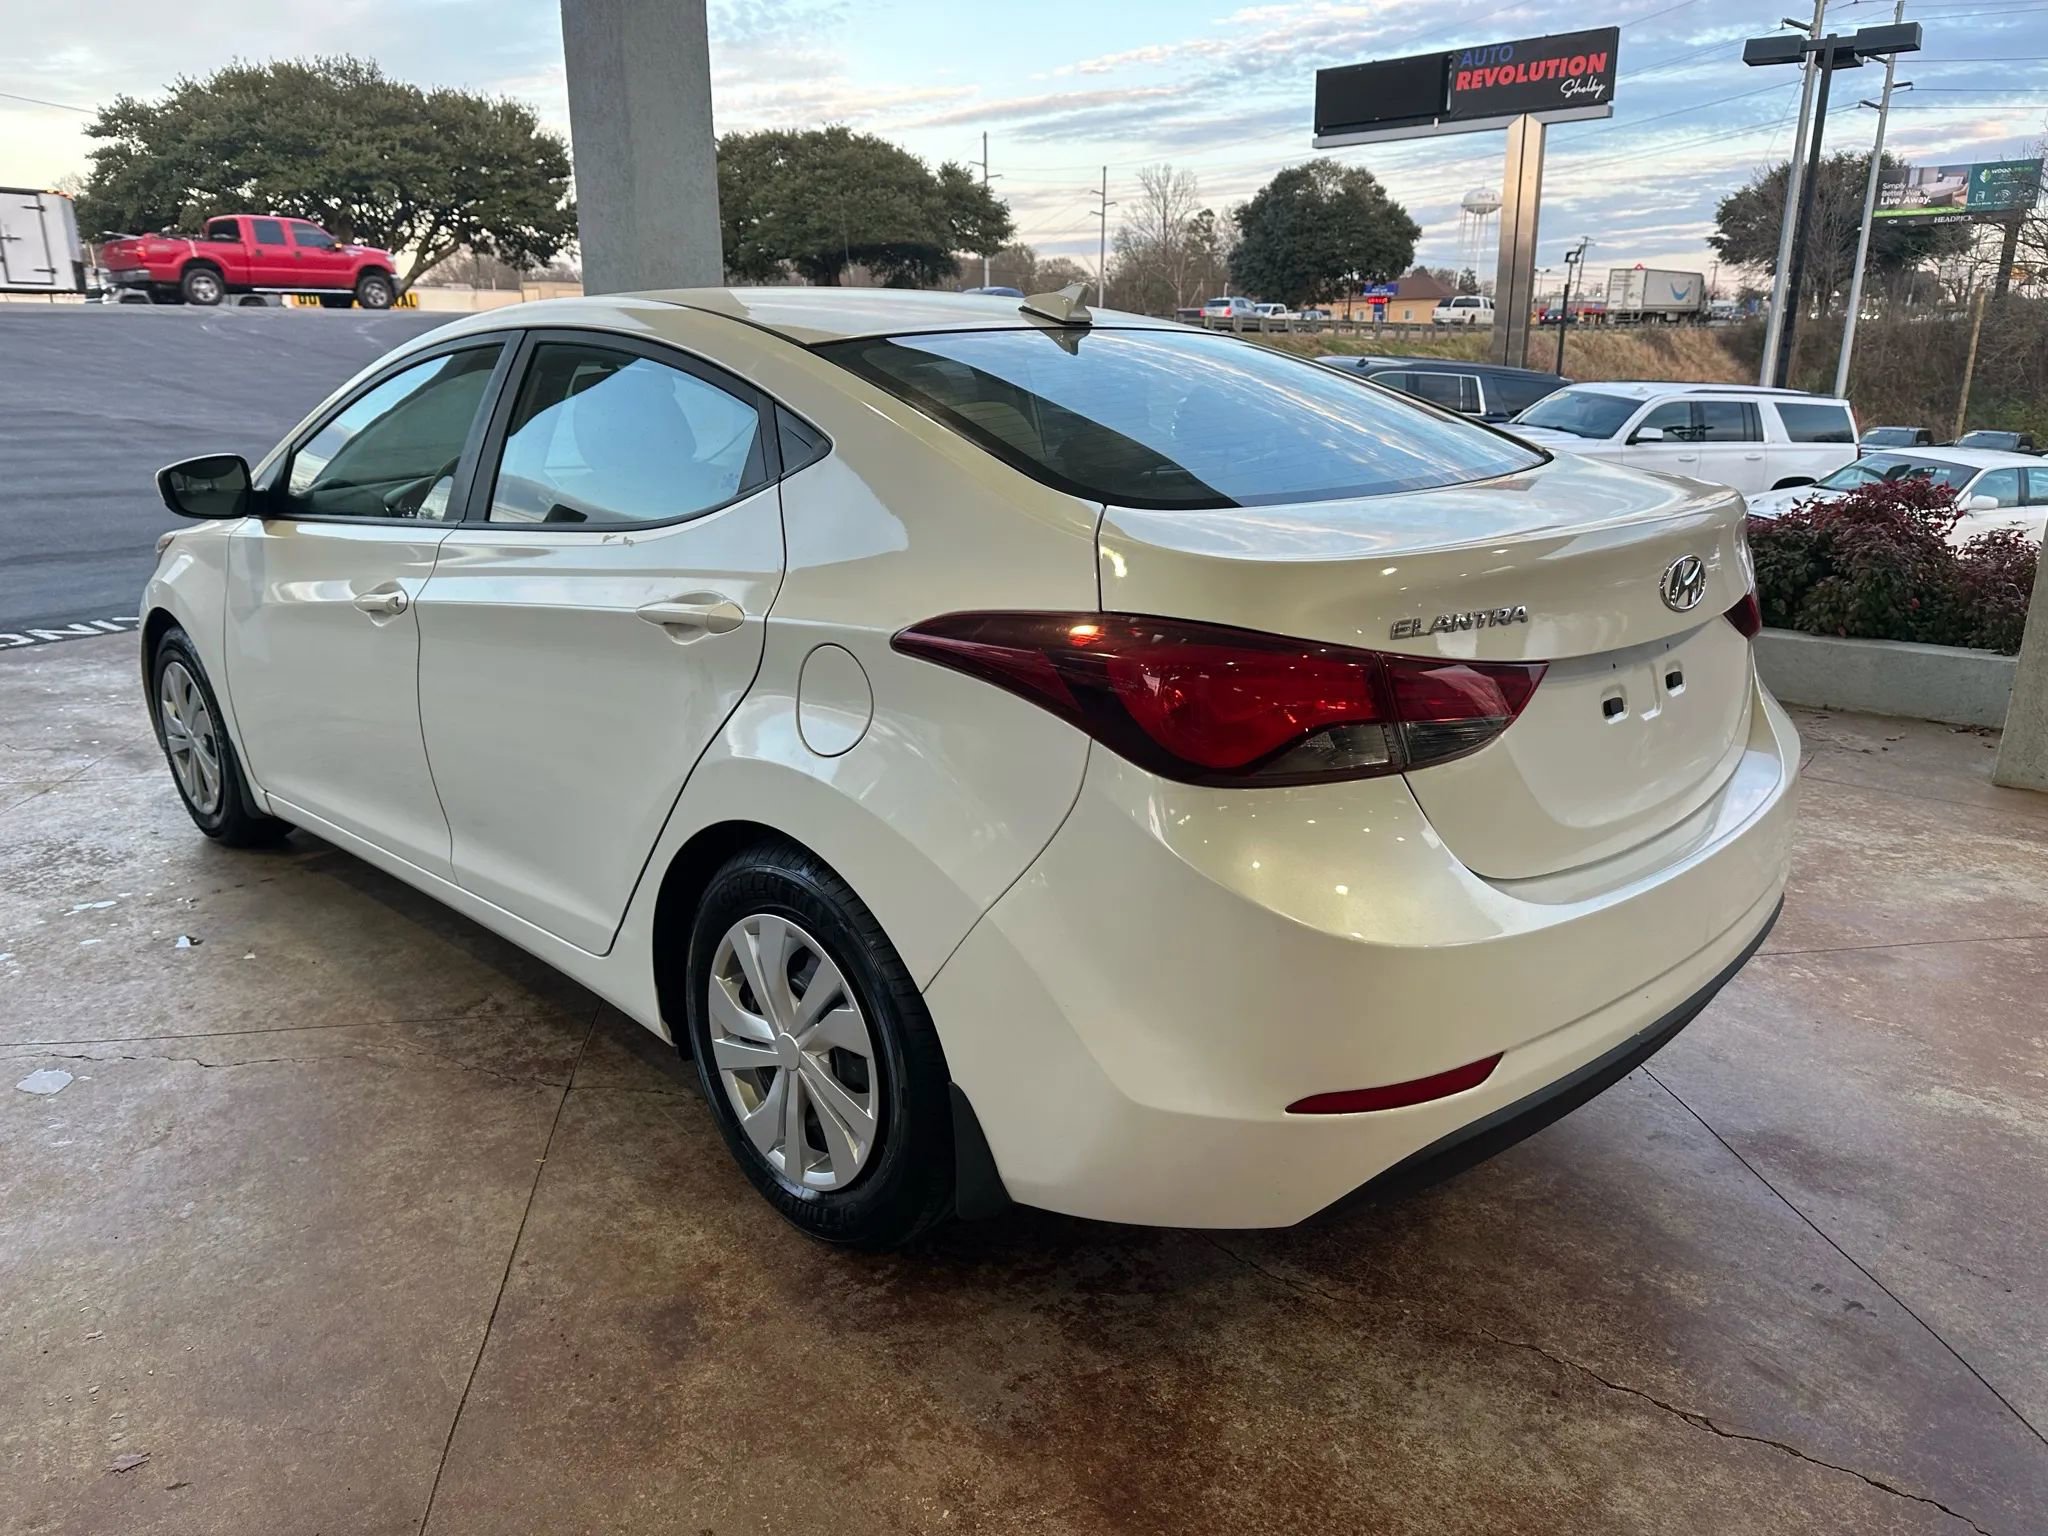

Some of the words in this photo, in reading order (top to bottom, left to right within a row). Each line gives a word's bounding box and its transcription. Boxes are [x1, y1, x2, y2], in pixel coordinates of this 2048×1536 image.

[1460, 45, 1514, 68] AUTO
[1456, 52, 1608, 91] REVOLUTION
[1560, 75, 1606, 98] Shelby
[1882, 182, 1907, 191] Simply
[1880, 197, 1901, 206] Live
[1390, 605, 1528, 640] ELANTRA
